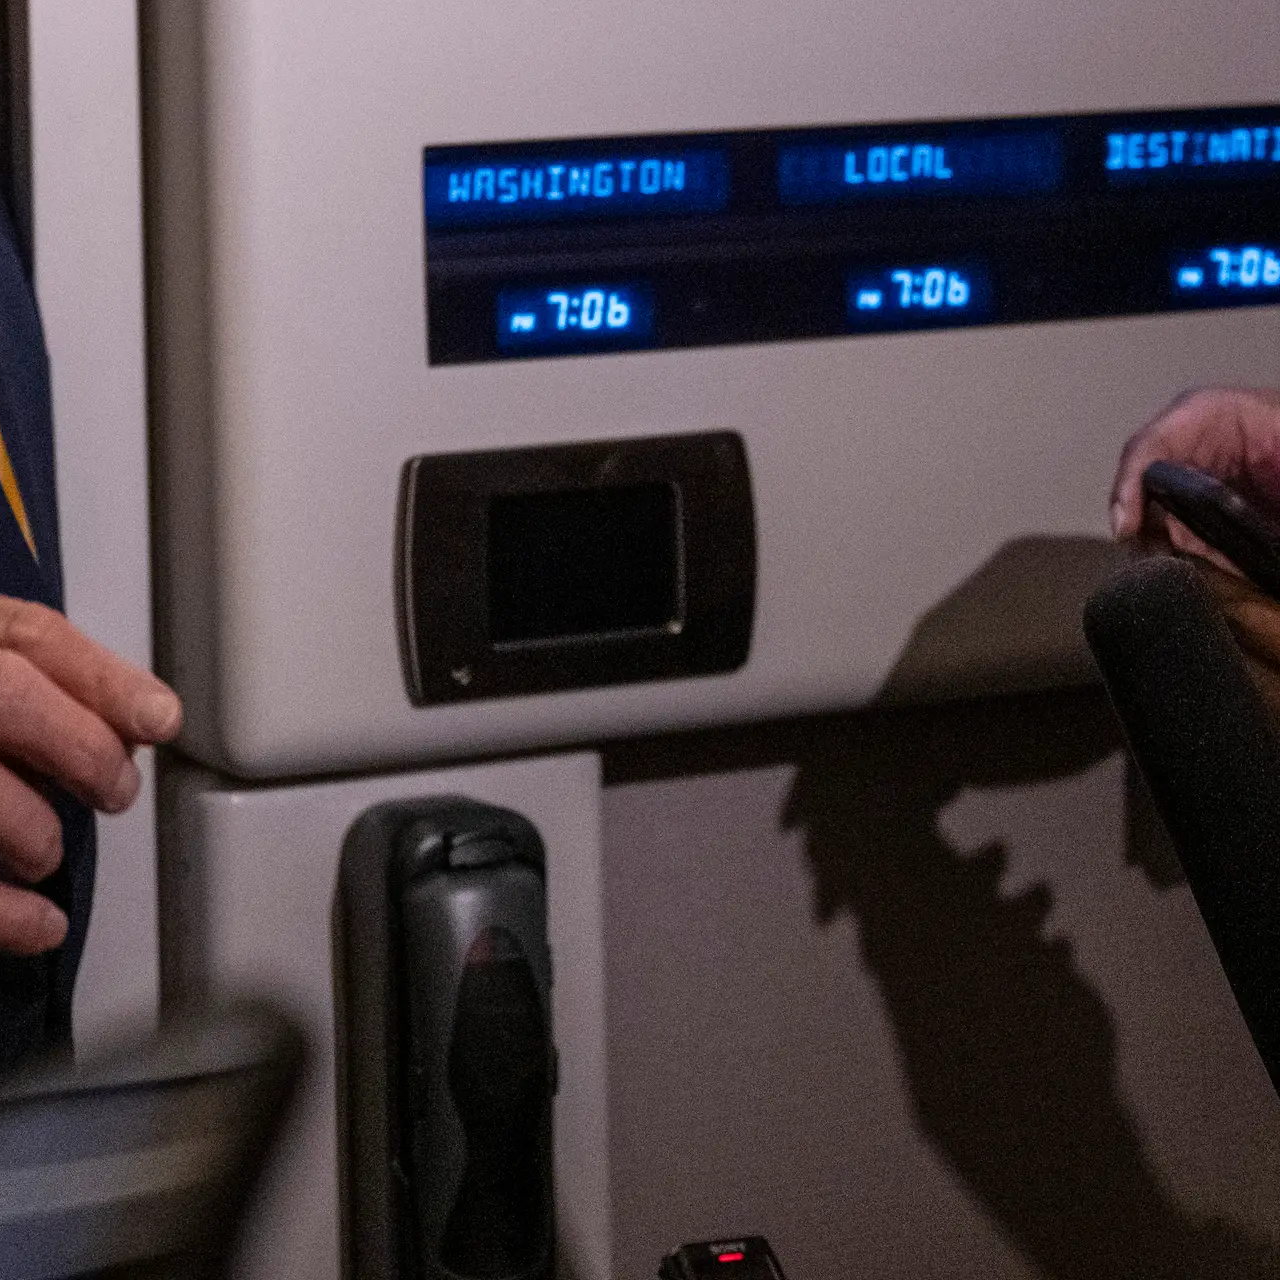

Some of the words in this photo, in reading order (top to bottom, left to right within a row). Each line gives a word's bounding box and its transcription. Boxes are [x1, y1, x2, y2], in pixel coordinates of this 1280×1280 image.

[448, 159, 686, 203] WASHINGTON
[845, 144, 953, 184] LOCAL
[891, 267, 970, 309] 7:06
[547, 289, 631, 331] 7:06
